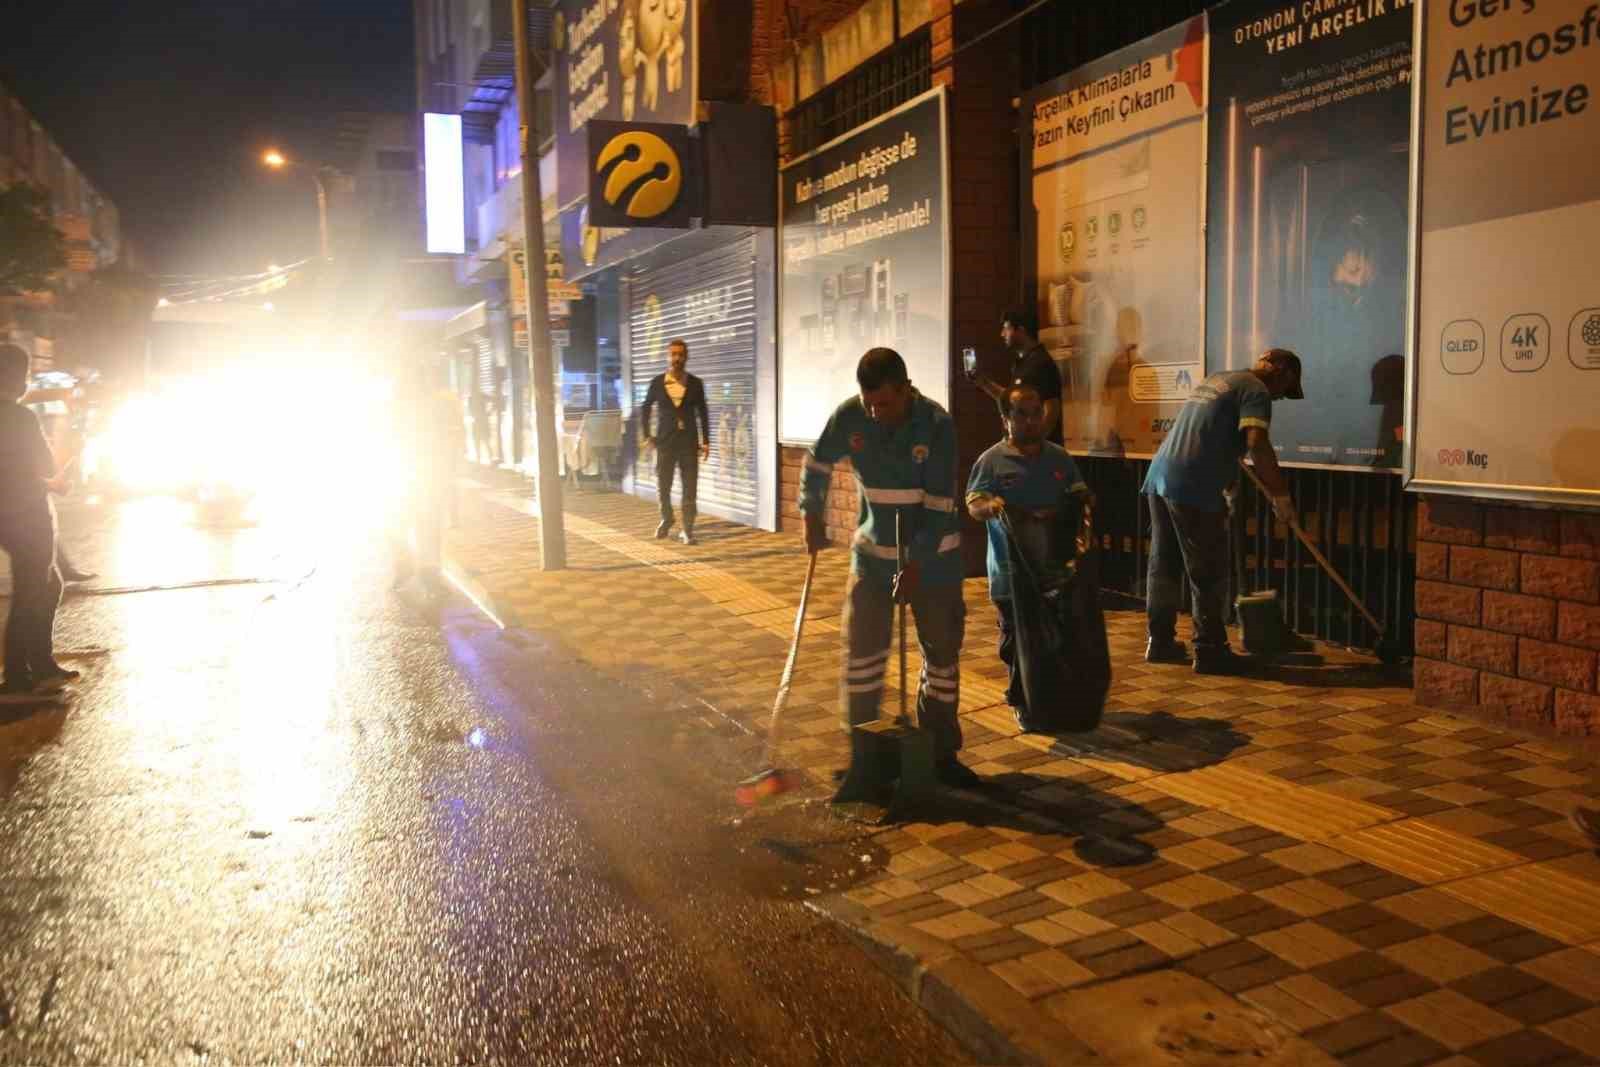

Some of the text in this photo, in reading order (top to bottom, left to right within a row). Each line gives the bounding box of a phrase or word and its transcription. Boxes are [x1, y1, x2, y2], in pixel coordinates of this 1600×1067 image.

[1235, 8, 1296, 44] OTONOM
[1267, 0, 1385, 54] YENİ ARÇELİK
[1445, 4, 1600, 89] Atmosf
[1078, 58, 1151, 104] Klimalarla
[1067, 99, 1116, 136] Keyfini
[1119, 83, 1175, 122] Çıkarın
[1445, 83, 1590, 145] Evinize
[900, 131, 917, 159] de
[1446, 339, 1478, 353] QLED
[1511, 325, 1539, 348] 4K
[1515, 350, 1534, 361] UHD
[1466, 449, 1488, 469] Koç
